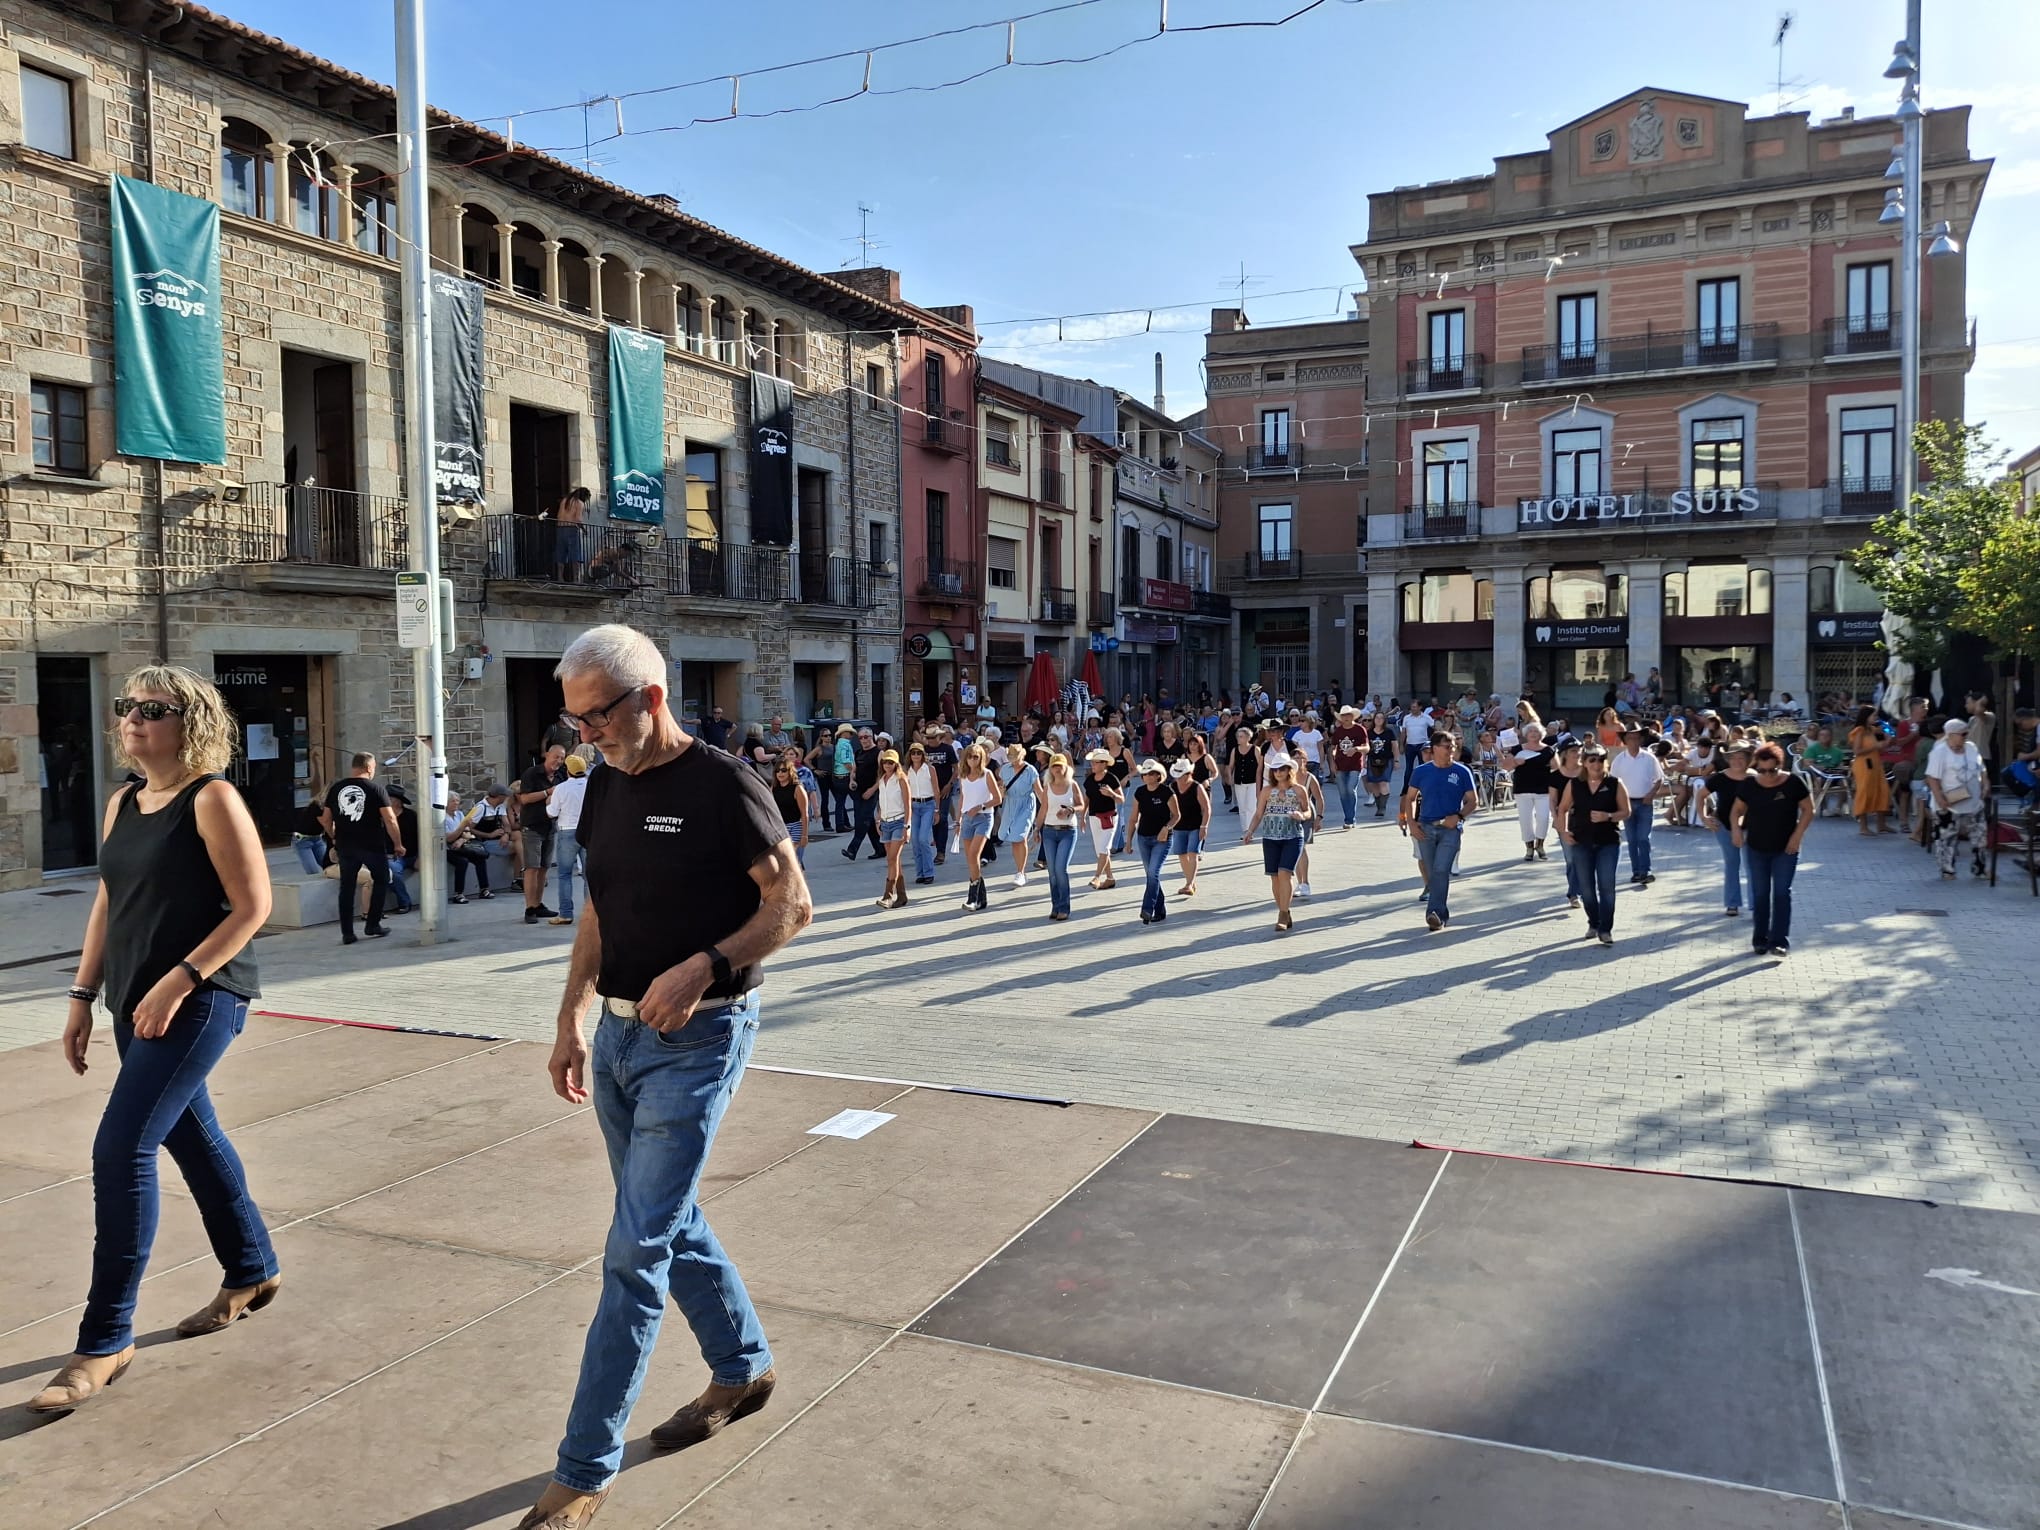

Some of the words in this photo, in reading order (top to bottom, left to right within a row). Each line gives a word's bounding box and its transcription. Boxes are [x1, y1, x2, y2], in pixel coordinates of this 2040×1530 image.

[157, 281, 189, 297] mont
[136, 288, 206, 318] Senys
[437, 460, 463, 473] mont
[435, 469, 481, 491] egres
[627, 482, 649, 494] mont
[616, 489, 660, 514] Senys
[1519, 494, 1643, 524] HOTEL
[1671, 487, 1760, 515] SUIS
[1557, 625, 1588, 635] Institut
[1590, 624, 1620, 634] Dental
[1842, 620, 1879, 629] Institut
[214, 672, 268, 685] urisme
[646, 815, 684, 826] COUNTRY
